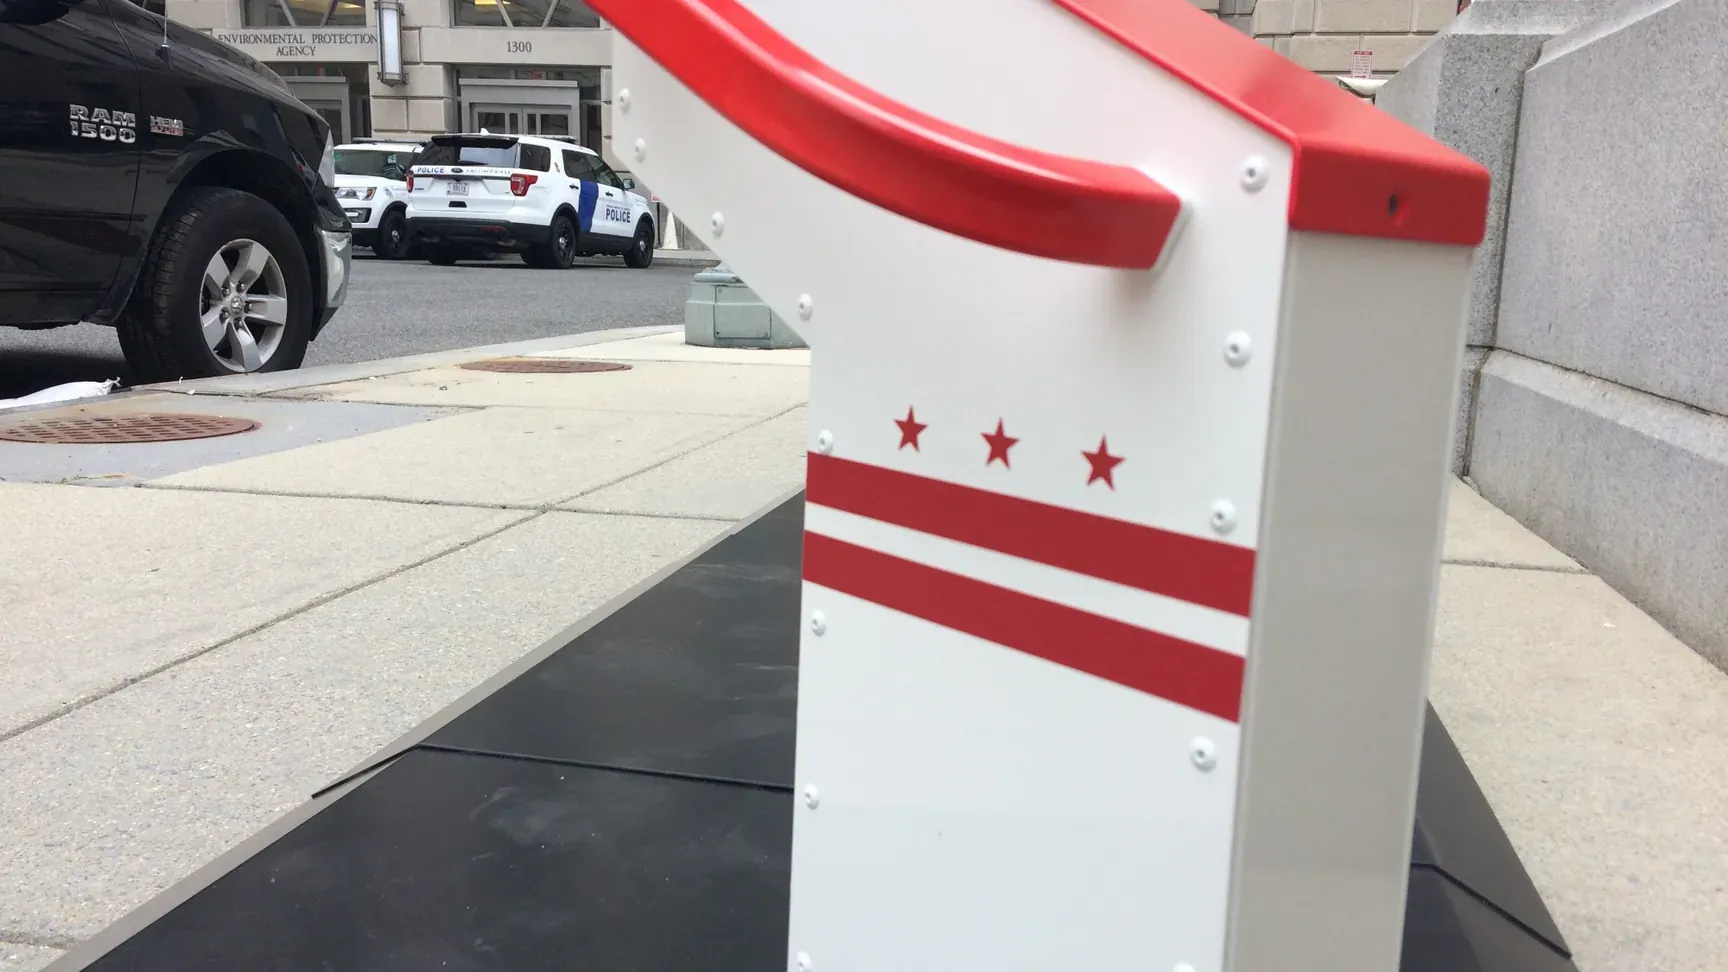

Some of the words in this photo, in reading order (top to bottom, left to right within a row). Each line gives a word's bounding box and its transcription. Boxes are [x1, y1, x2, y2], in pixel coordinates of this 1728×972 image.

[218, 33, 305, 44] ENVIRONMENTAL
[312, 33, 378, 44] PROTECTION
[276, 46, 316, 56] AGENCY
[507, 41, 532, 52] 1300
[69, 104, 136, 127] RAM
[70, 120, 136, 143] 1500
[605, 208, 631, 223] POLICE
